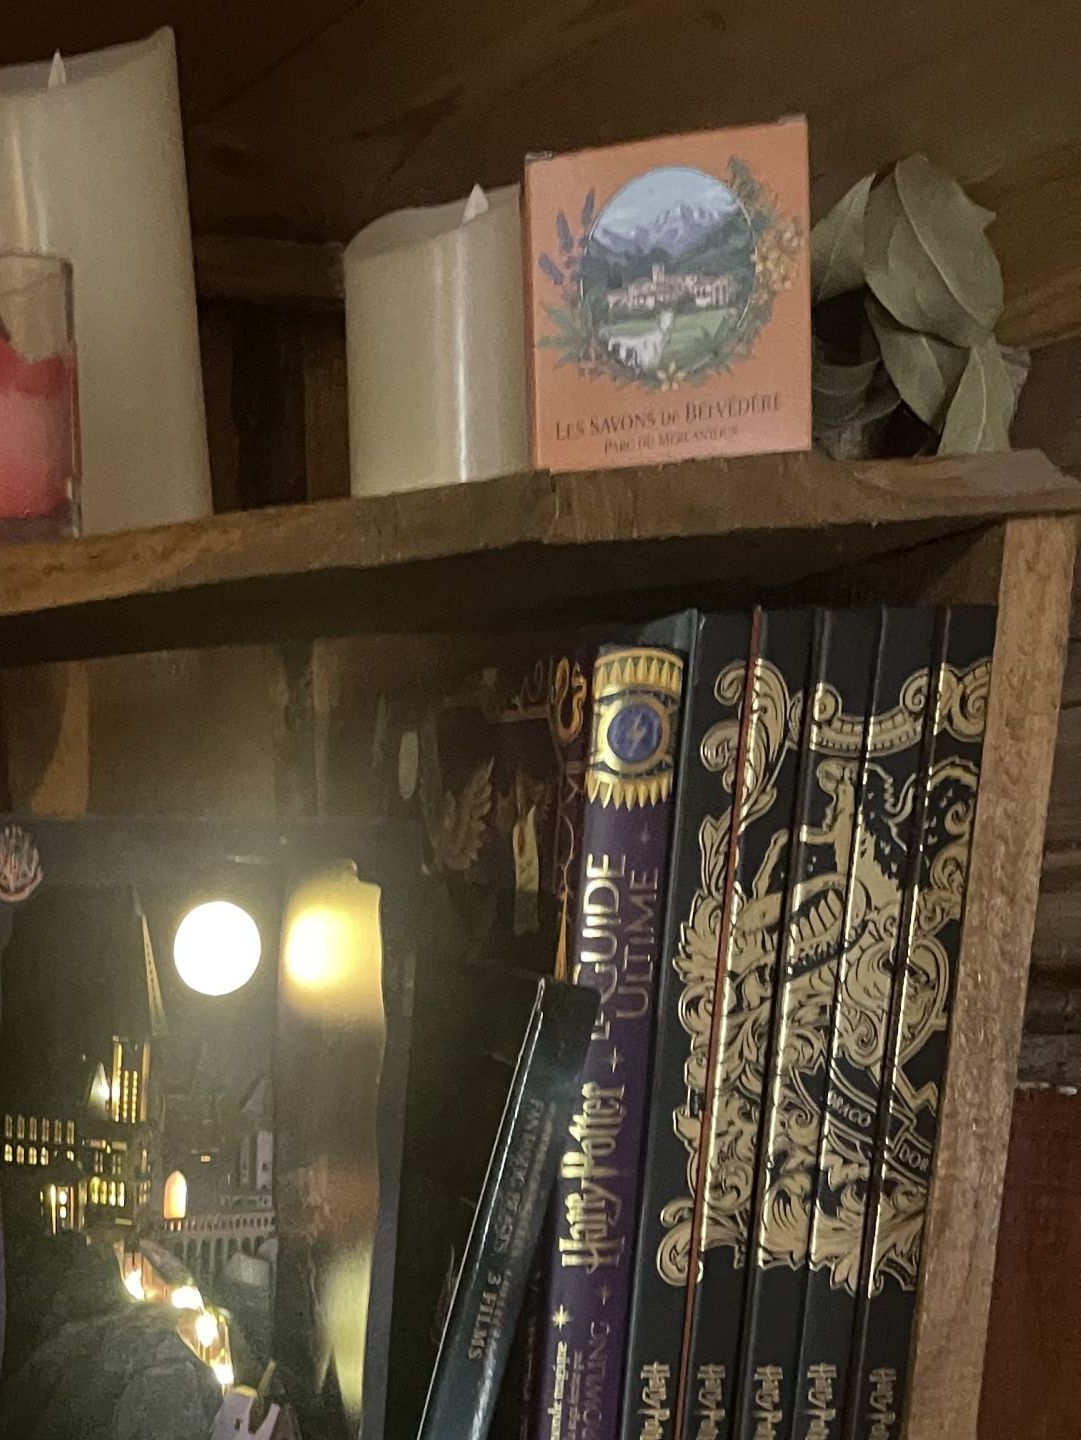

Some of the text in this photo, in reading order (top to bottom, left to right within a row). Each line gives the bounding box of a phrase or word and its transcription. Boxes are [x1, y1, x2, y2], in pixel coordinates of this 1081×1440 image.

[556, 421, 585, 441] LES
[589, 411, 657, 436] SAVONS
[661, 411, 679, 427] DE
[617, 867, 658, 1020] ULTIME
[559, 1080, 628, 1275] Harry Potter
